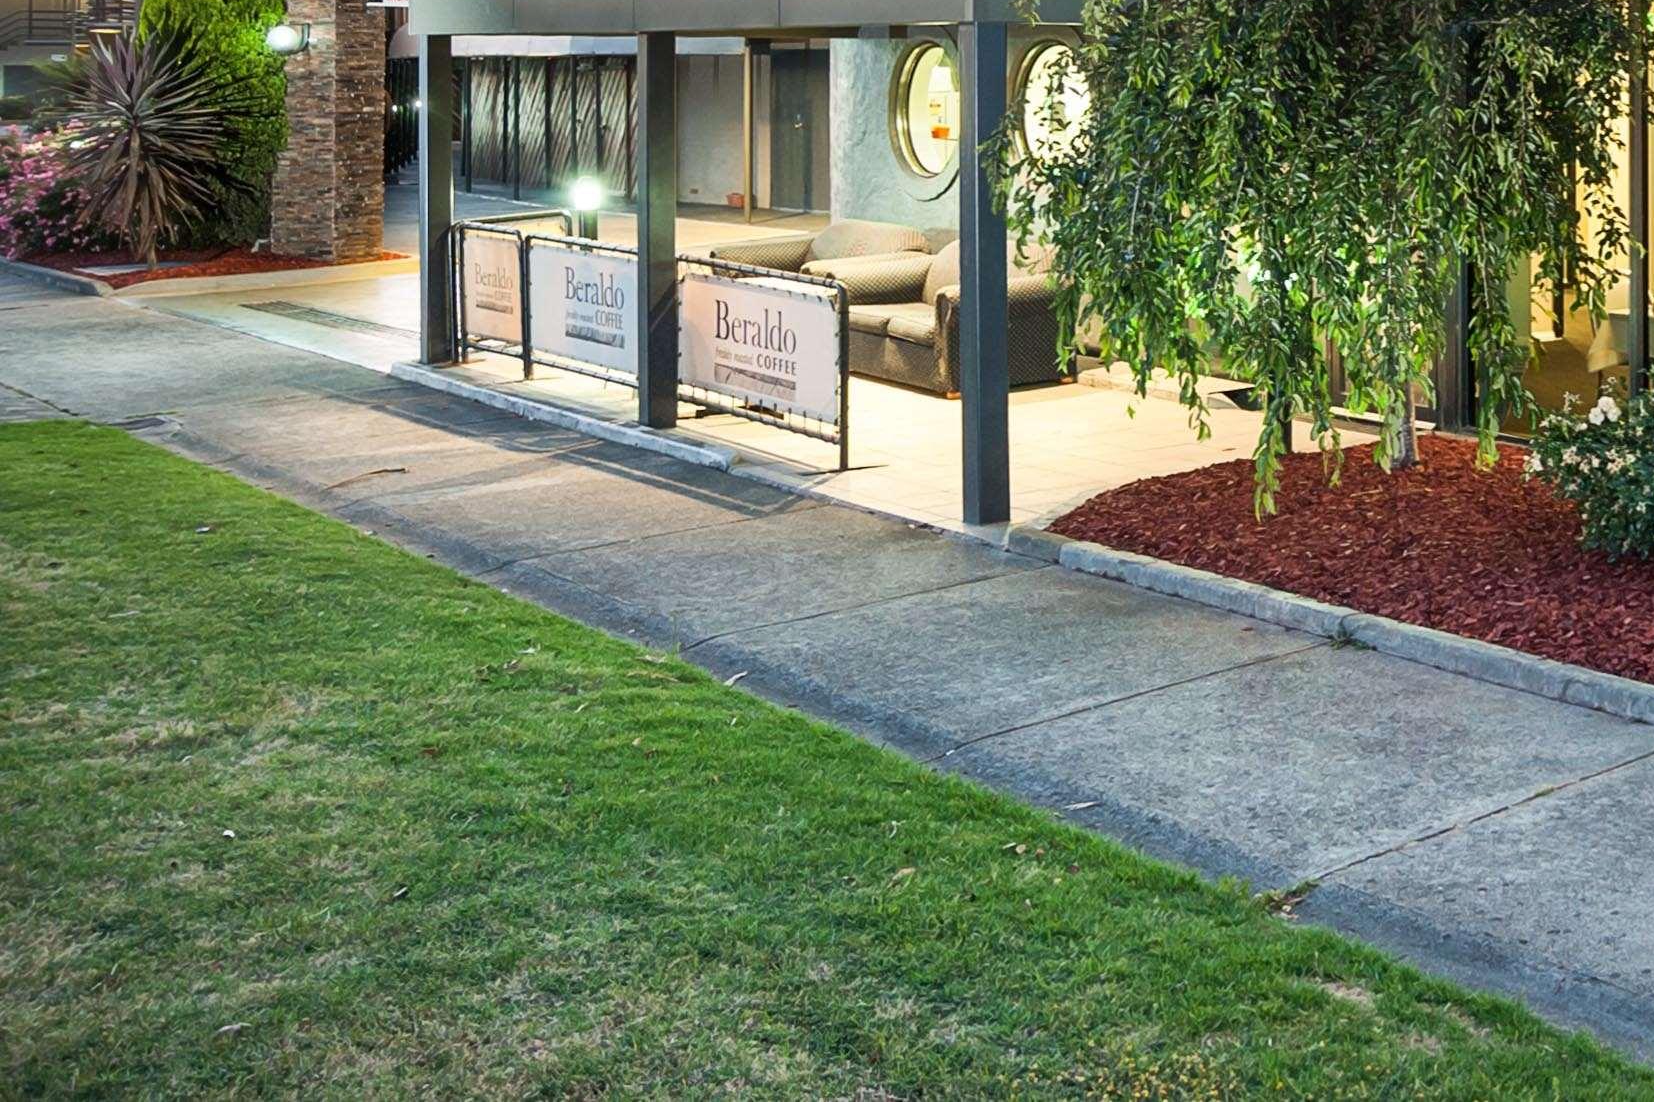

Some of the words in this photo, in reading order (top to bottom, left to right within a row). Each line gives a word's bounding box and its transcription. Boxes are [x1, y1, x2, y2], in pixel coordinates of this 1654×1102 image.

[474, 262, 513, 290] Beraldo
[565, 266, 625, 310] Beraldo
[595, 309, 623, 330] COFFEE
[715, 299, 797, 355] Beraldo
[756, 353, 798, 376] COFFEE
